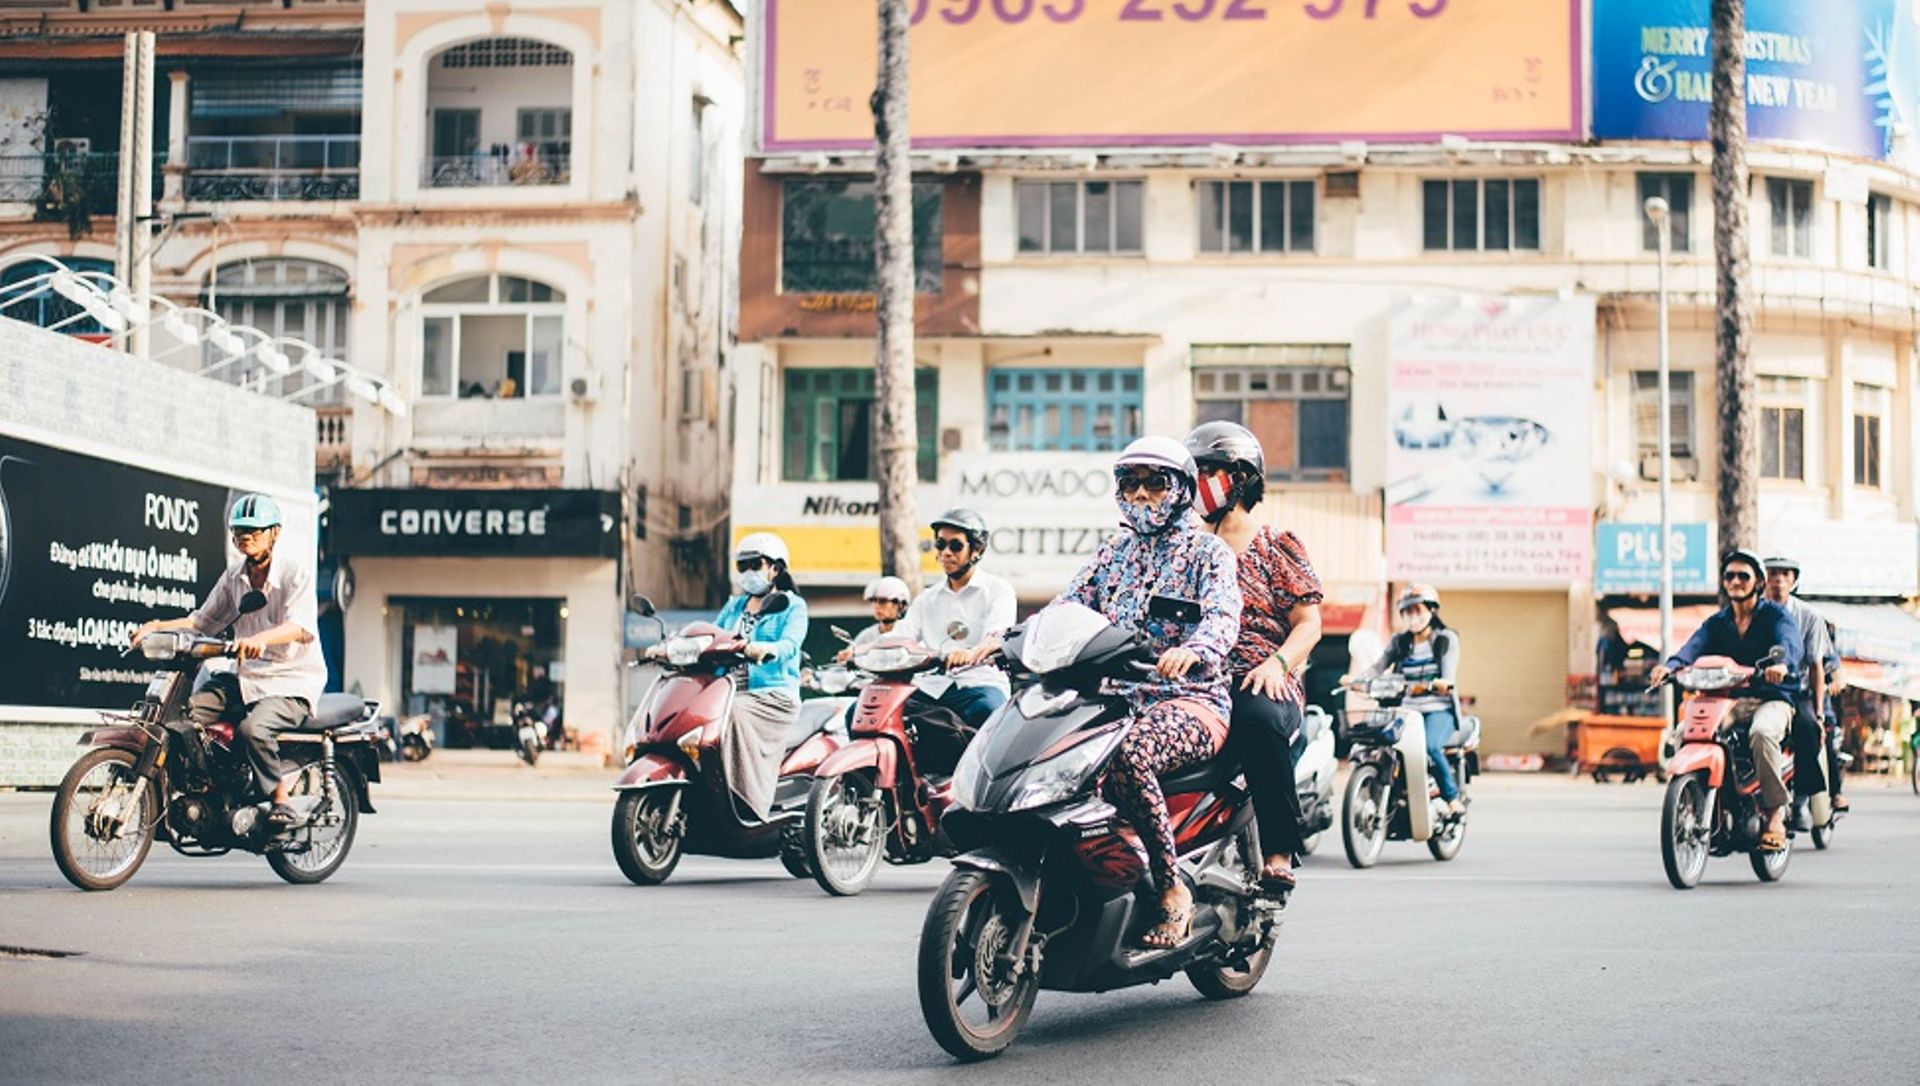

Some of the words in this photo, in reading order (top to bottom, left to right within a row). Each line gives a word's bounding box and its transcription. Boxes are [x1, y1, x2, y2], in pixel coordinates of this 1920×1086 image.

[1641, 27, 1708, 56] MERRY
[1634, 55, 1677, 103] &
[1747, 74, 1790, 107] NEW
[1792, 79, 1838, 112] YEAR
[960, 468, 1111, 498] MOVADO
[803, 496, 880, 516] Nikon
[380, 510, 546, 535] CONVERSE
[91, 538, 124, 572] KHÓI
[125, 547, 147, 579] BỤI
[147, 545, 158, 577] Ô
[28, 618, 36, 638] 3
